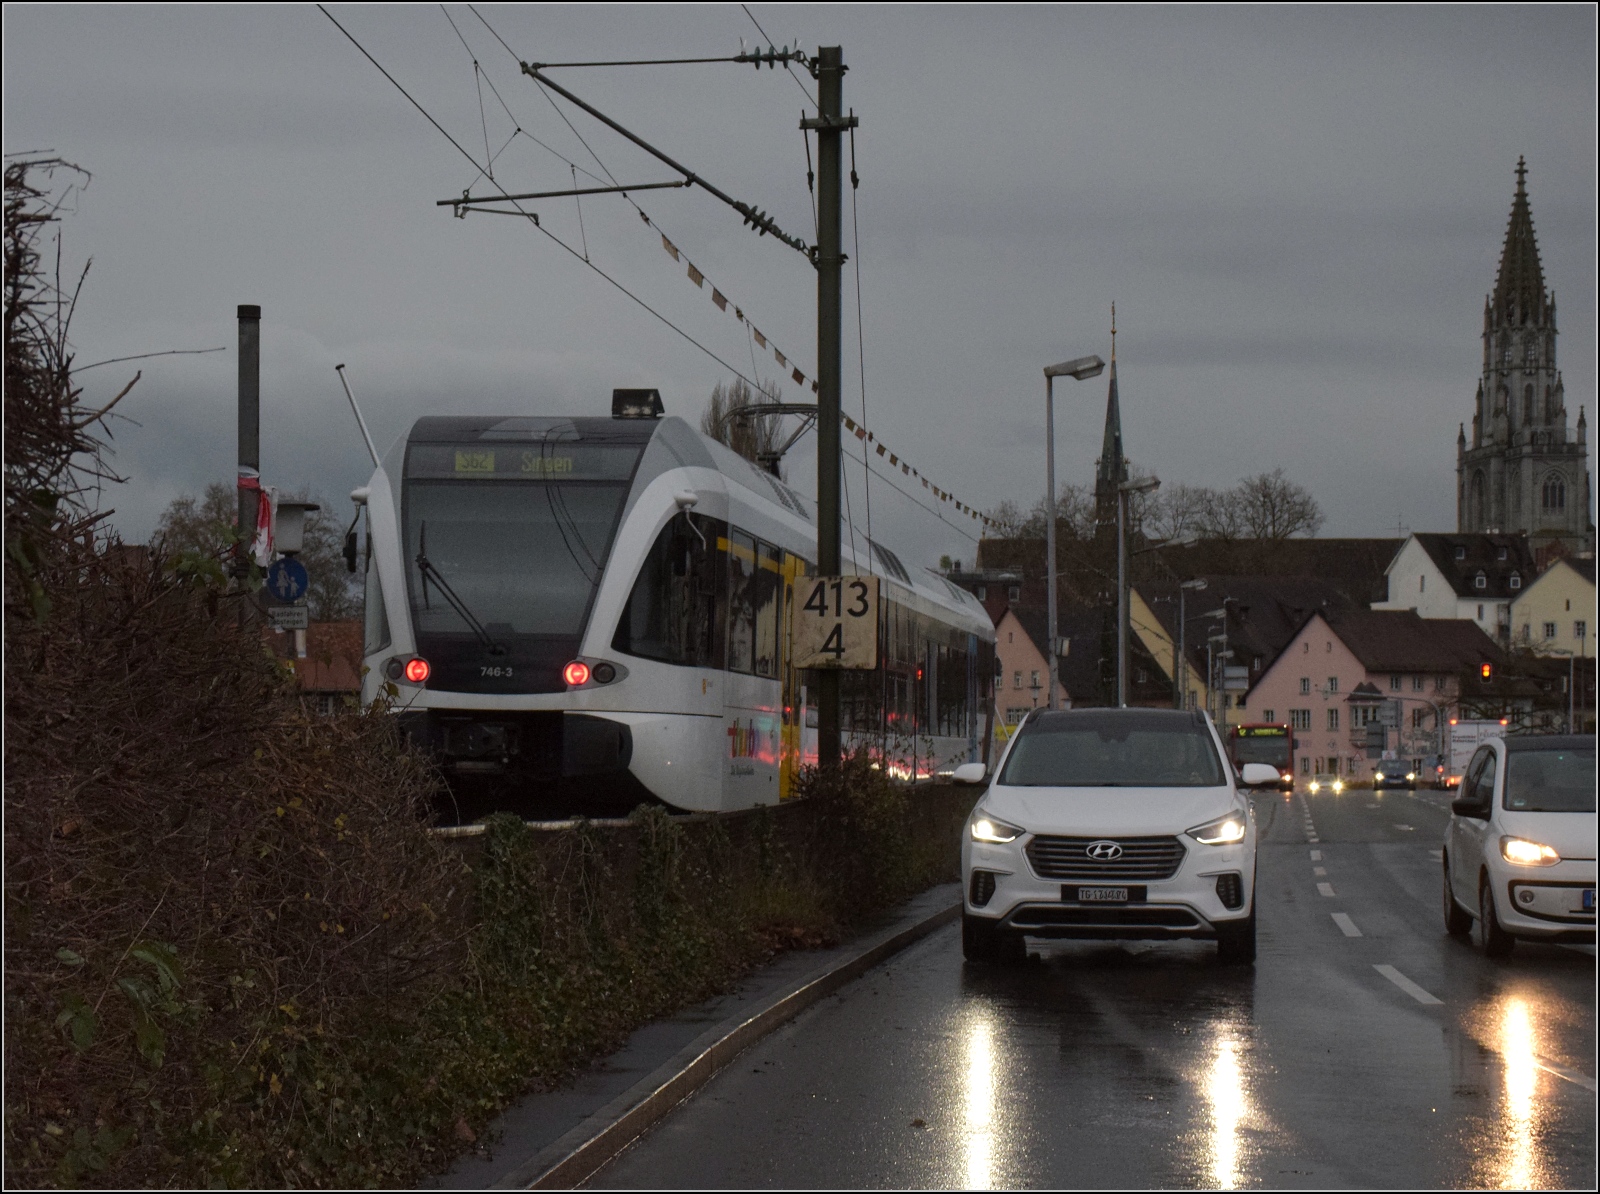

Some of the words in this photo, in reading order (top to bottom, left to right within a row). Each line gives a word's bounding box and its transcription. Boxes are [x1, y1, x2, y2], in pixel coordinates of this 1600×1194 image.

[521, 451, 573, 472] Singen
[803, 580, 869, 617] 413
[820, 622, 845, 659] 4
[480, 666, 513, 677] 746-3
